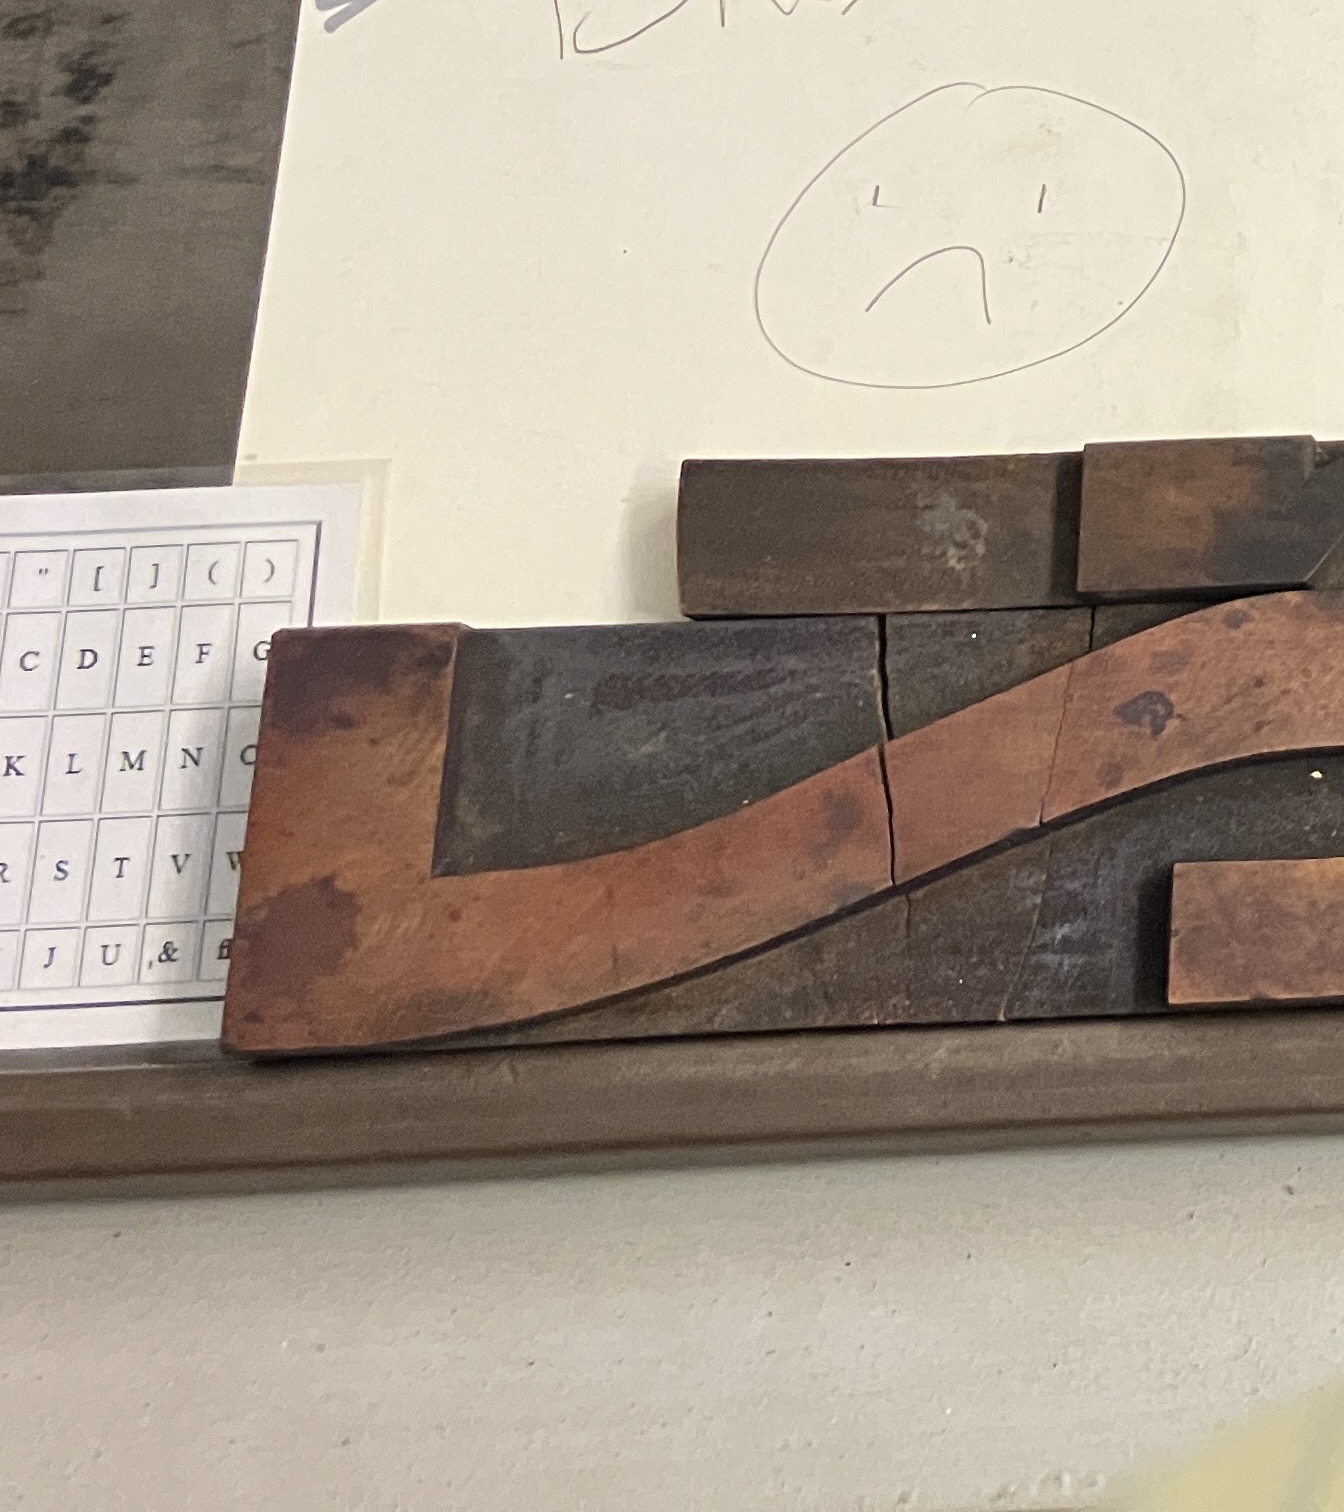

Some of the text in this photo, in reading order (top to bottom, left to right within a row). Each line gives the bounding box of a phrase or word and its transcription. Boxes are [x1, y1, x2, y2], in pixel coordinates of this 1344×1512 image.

[19, 650, 40, 672] C
[76, 648, 99, 670] D
[136, 645, 156, 667] E
[194, 642, 213, 665] F
[2, 754, 27, 777] K
[64, 752, 84, 775] L
[118, 749, 148, 773] M
[179, 746, 205, 769] N
[53, 859, 70, 882] S
[113, 856, 131, 879] T
[170, 853, 192, 875] V
[43, 946, 57, 969] J
[100, 943, 122, 966] U
[157, 940, 179, 963] &
